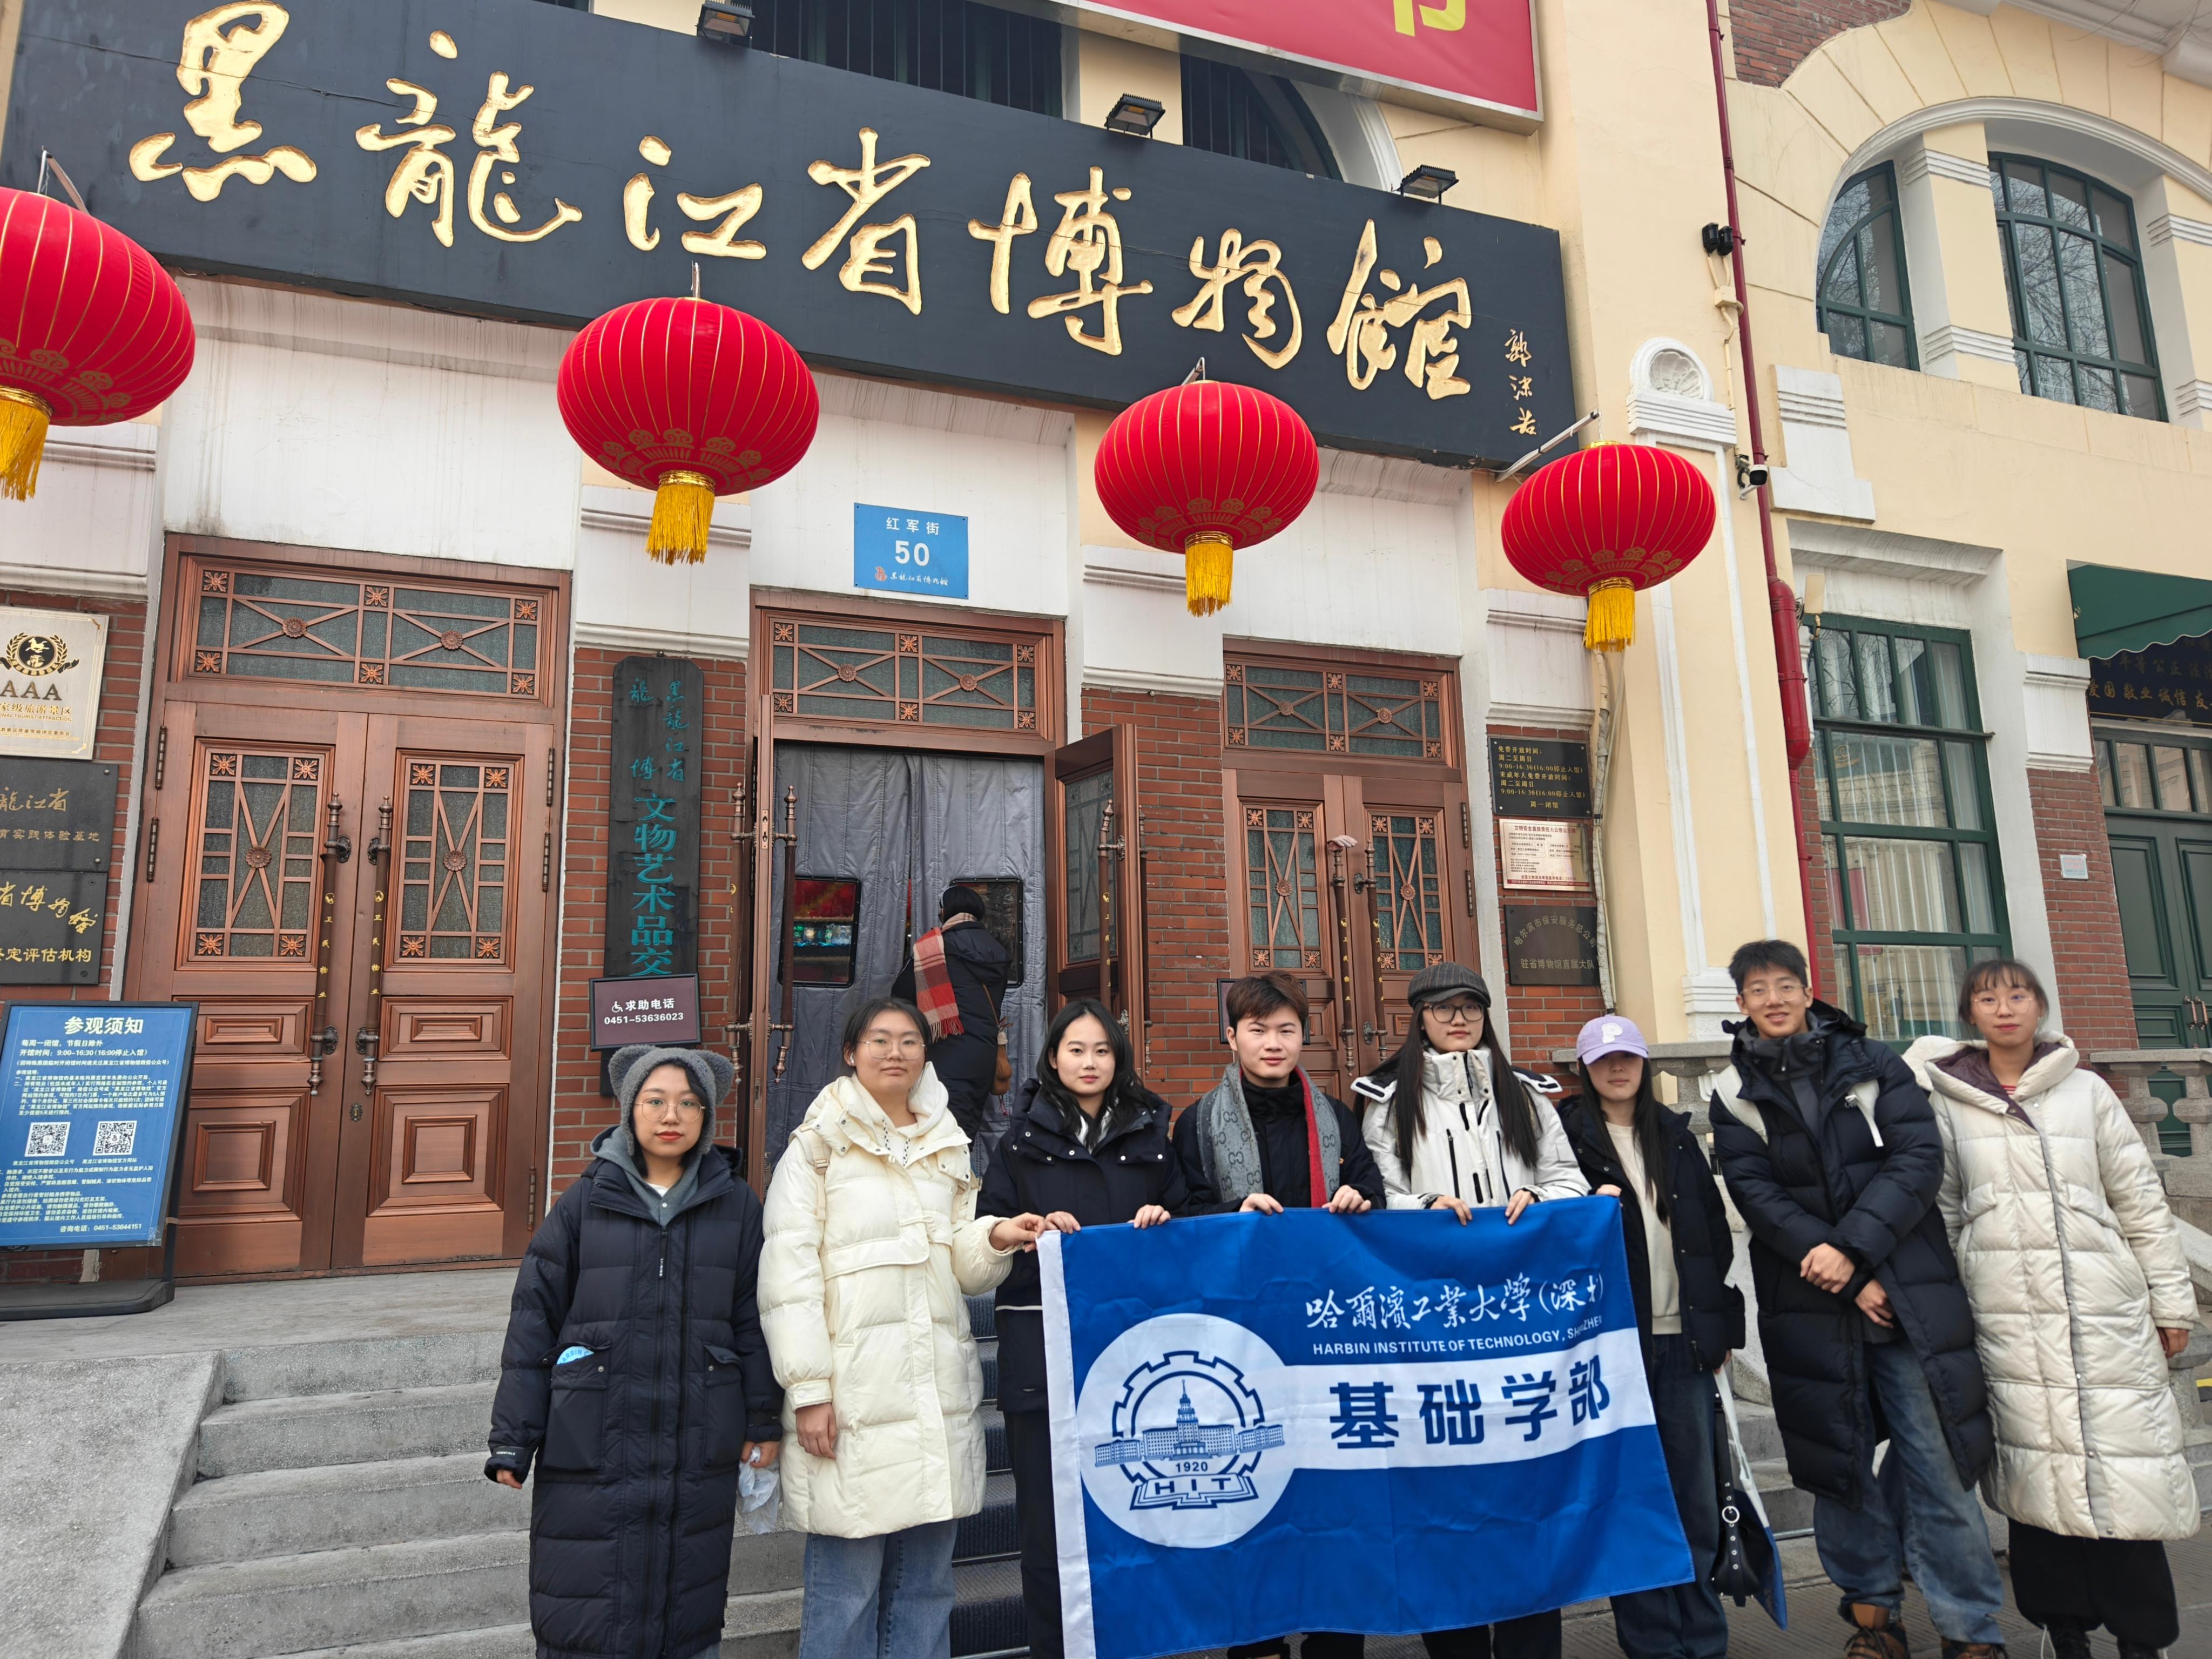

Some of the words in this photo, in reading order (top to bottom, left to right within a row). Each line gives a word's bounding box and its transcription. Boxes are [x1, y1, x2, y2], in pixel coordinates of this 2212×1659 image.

[886, 517, 940, 536] 红军街
[894, 539, 930, 567] 50
[0, 680, 62, 701] AAA
[1498, 745, 1542, 754] 免费开放时间：
[1499, 754, 1532, 763] 周二至周日
[1500, 771, 1572, 781] 未成年人免费开放时间：
[1501, 779, 1534, 787] 周二至周日
[1530, 800, 1559, 809] 周一闭馆
[629, 790, 677, 977] 文物艺术品交
[1514, 914, 1597, 948] 哈尔滨市保安服务总公司
[1520, 958, 1595, 970] 驻省博物馆直属大队
[625, 997, 676, 1011] 求助电话
[63, 1016, 144, 1035] 参观须知
[604, 1012, 684, 1025] 0451-53636023
[1601, 1022, 1623, 1044] P
[1313, 1343, 1371, 1355] HARBIN
[1373, 1340, 1447, 1354] INSTITUTE
[1449, 1339, 1465, 1352] OF
[559, 1349, 582, 1365] ARBIN
[1329, 1354, 1611, 1449] 基础学部
[1175, 1461, 1209, 1473] 1920
[1155, 1477, 1231, 1495] HIT
